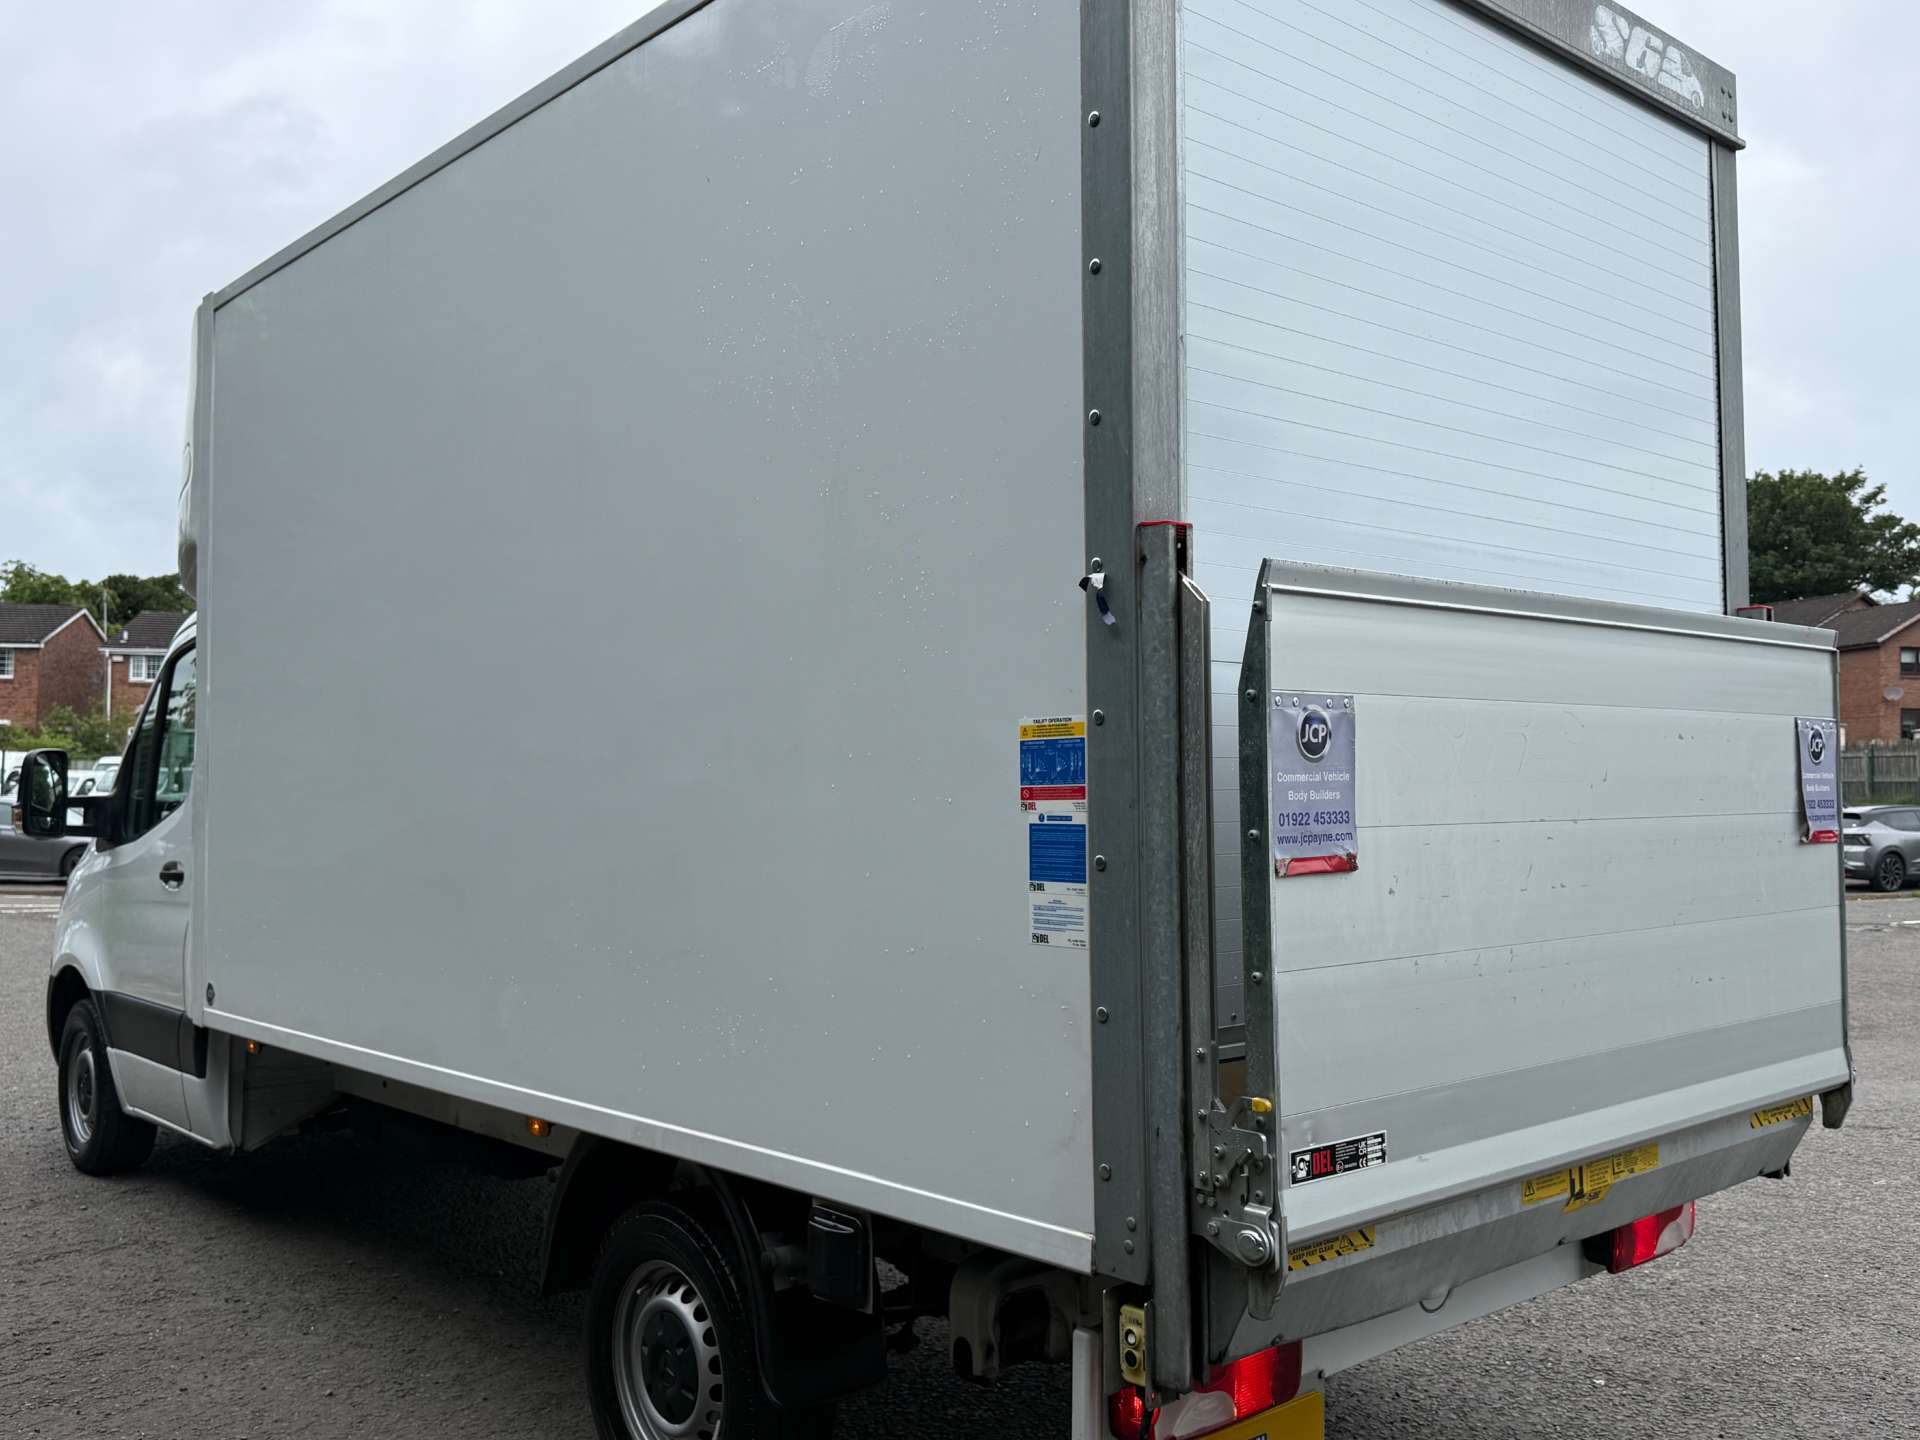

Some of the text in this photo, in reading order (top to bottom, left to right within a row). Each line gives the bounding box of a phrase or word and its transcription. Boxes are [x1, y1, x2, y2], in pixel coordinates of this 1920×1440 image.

[1301, 723, 1327, 743] JCP
[1276, 770, 1350, 783] Commercial Vehicle
[1288, 789, 1341, 803] Body Builders
[1278, 810, 1351, 828] 01922 453333
[1276, 830, 1354, 847] www.jcpayne.com
[1312, 1149, 1334, 1175] DEL
